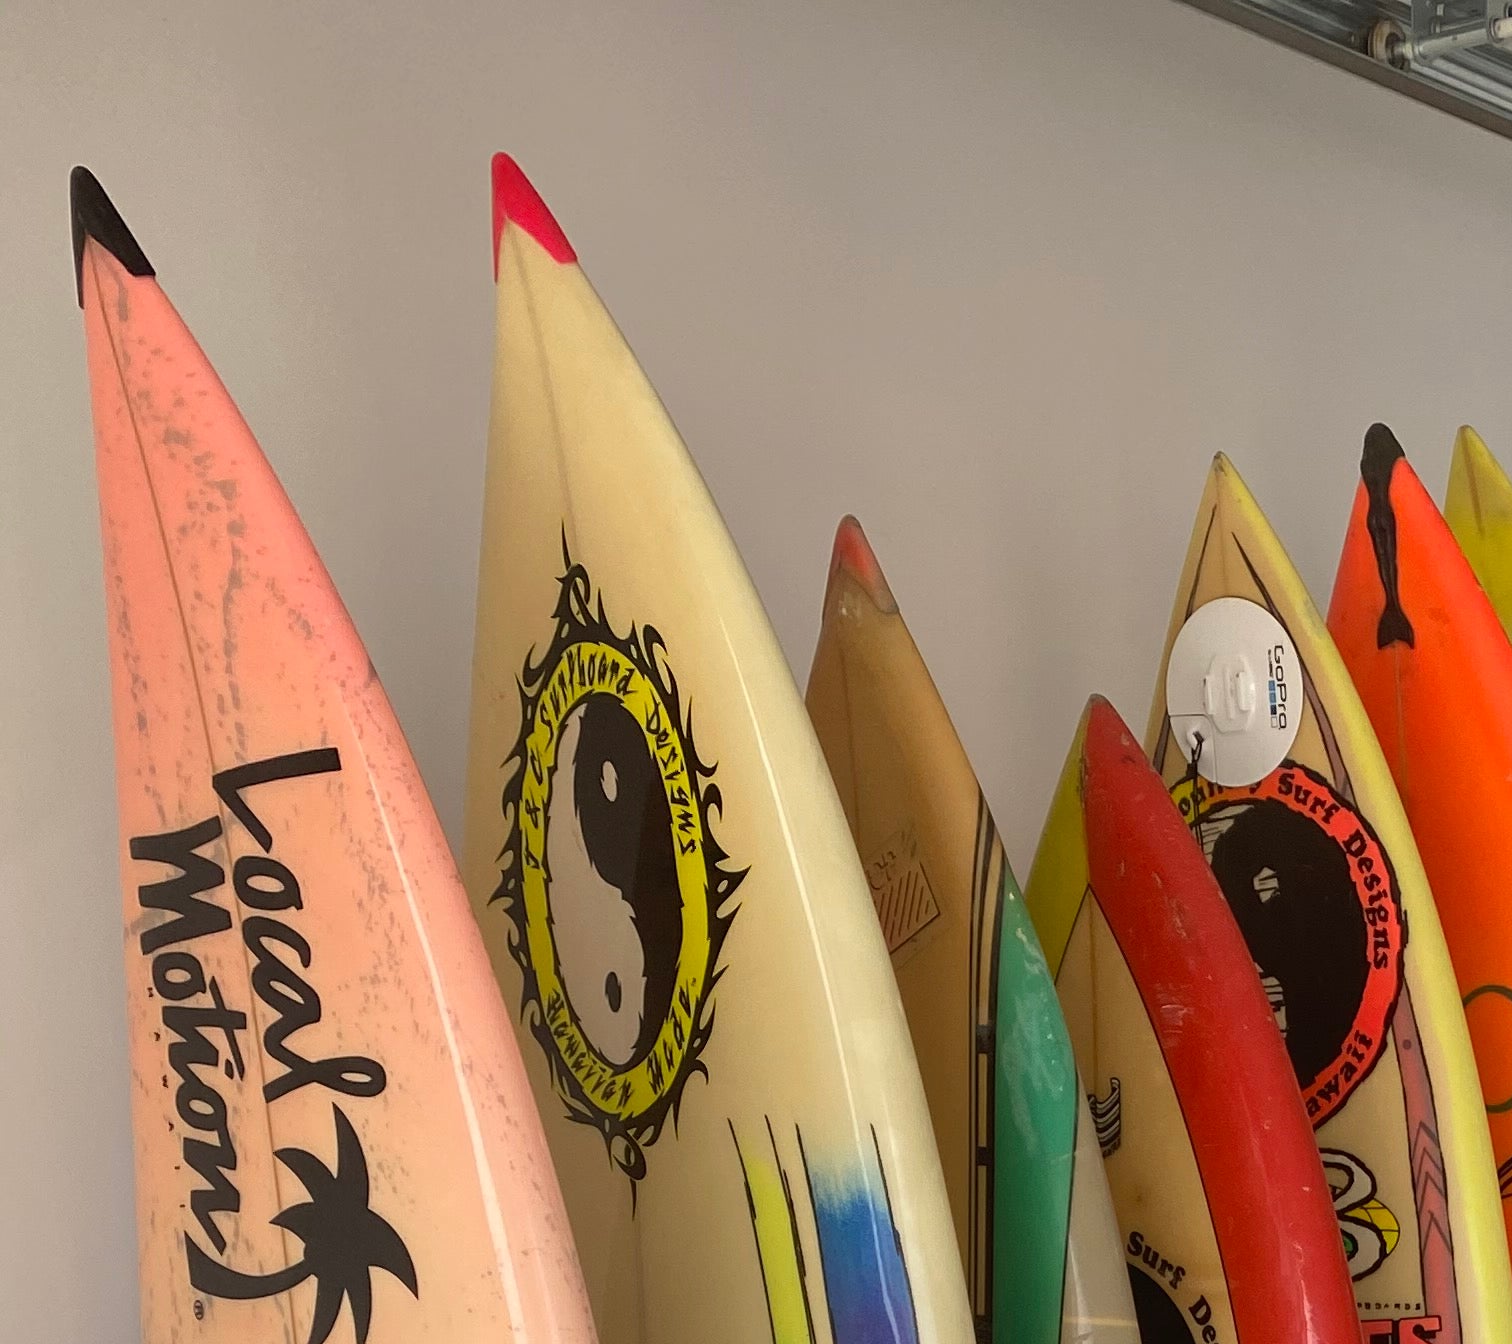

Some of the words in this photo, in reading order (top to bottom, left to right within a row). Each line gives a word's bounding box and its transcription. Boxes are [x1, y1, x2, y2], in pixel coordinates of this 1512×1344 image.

[1274, 645, 1287, 729] GoPro
[212, 747, 387, 1103] Local
[1278, 773, 1340, 824] Surf
[1342, 828, 1390, 970] Designs
[129, 816, 249, 1256] Motion
[1304, 1030, 1374, 1117] awaii
[1127, 1231, 1186, 1290] Surf
